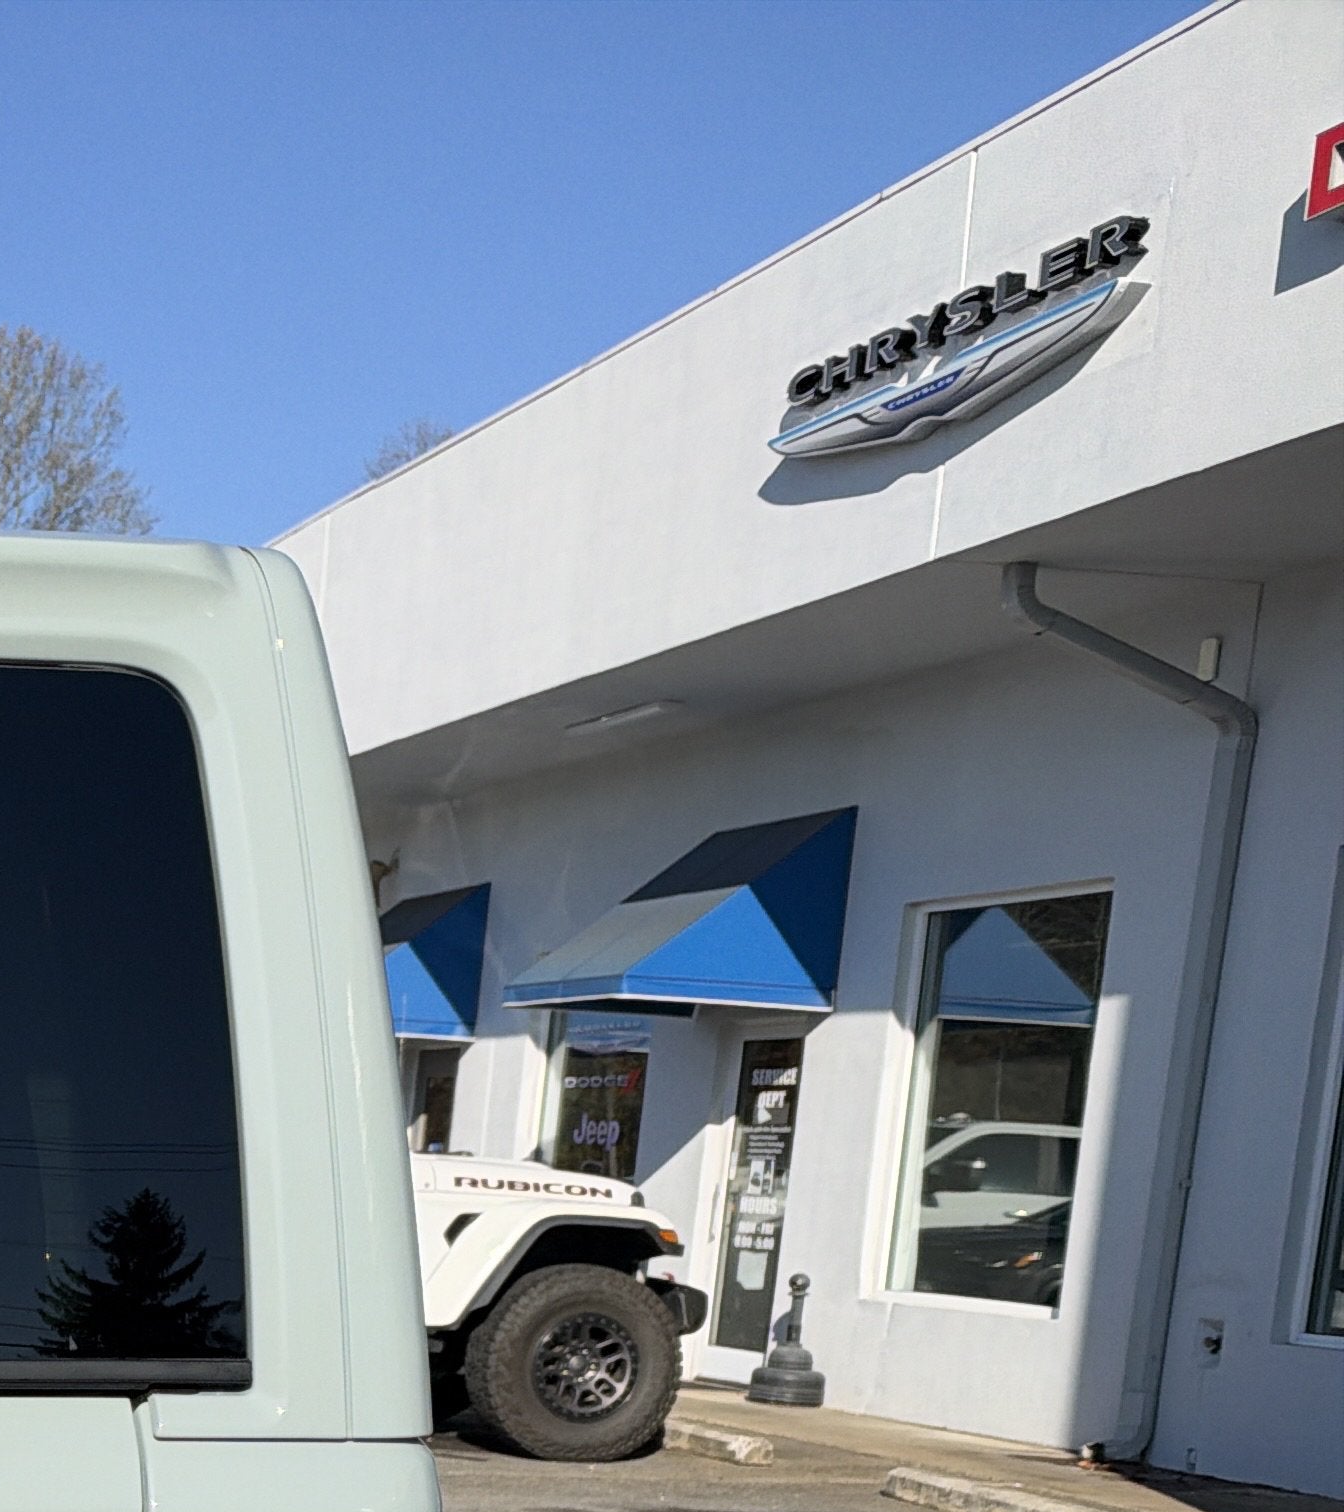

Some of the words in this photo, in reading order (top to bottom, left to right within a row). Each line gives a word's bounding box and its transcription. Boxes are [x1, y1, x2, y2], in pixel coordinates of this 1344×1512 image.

[786, 214, 1150, 406] CHRYSLER
[564, 1075, 629, 1089] DODGE
[752, 1067, 798, 1086] SERVICE
[572, 1112, 620, 1150] Jeep
[453, 1176, 613, 1199] RUBICON
